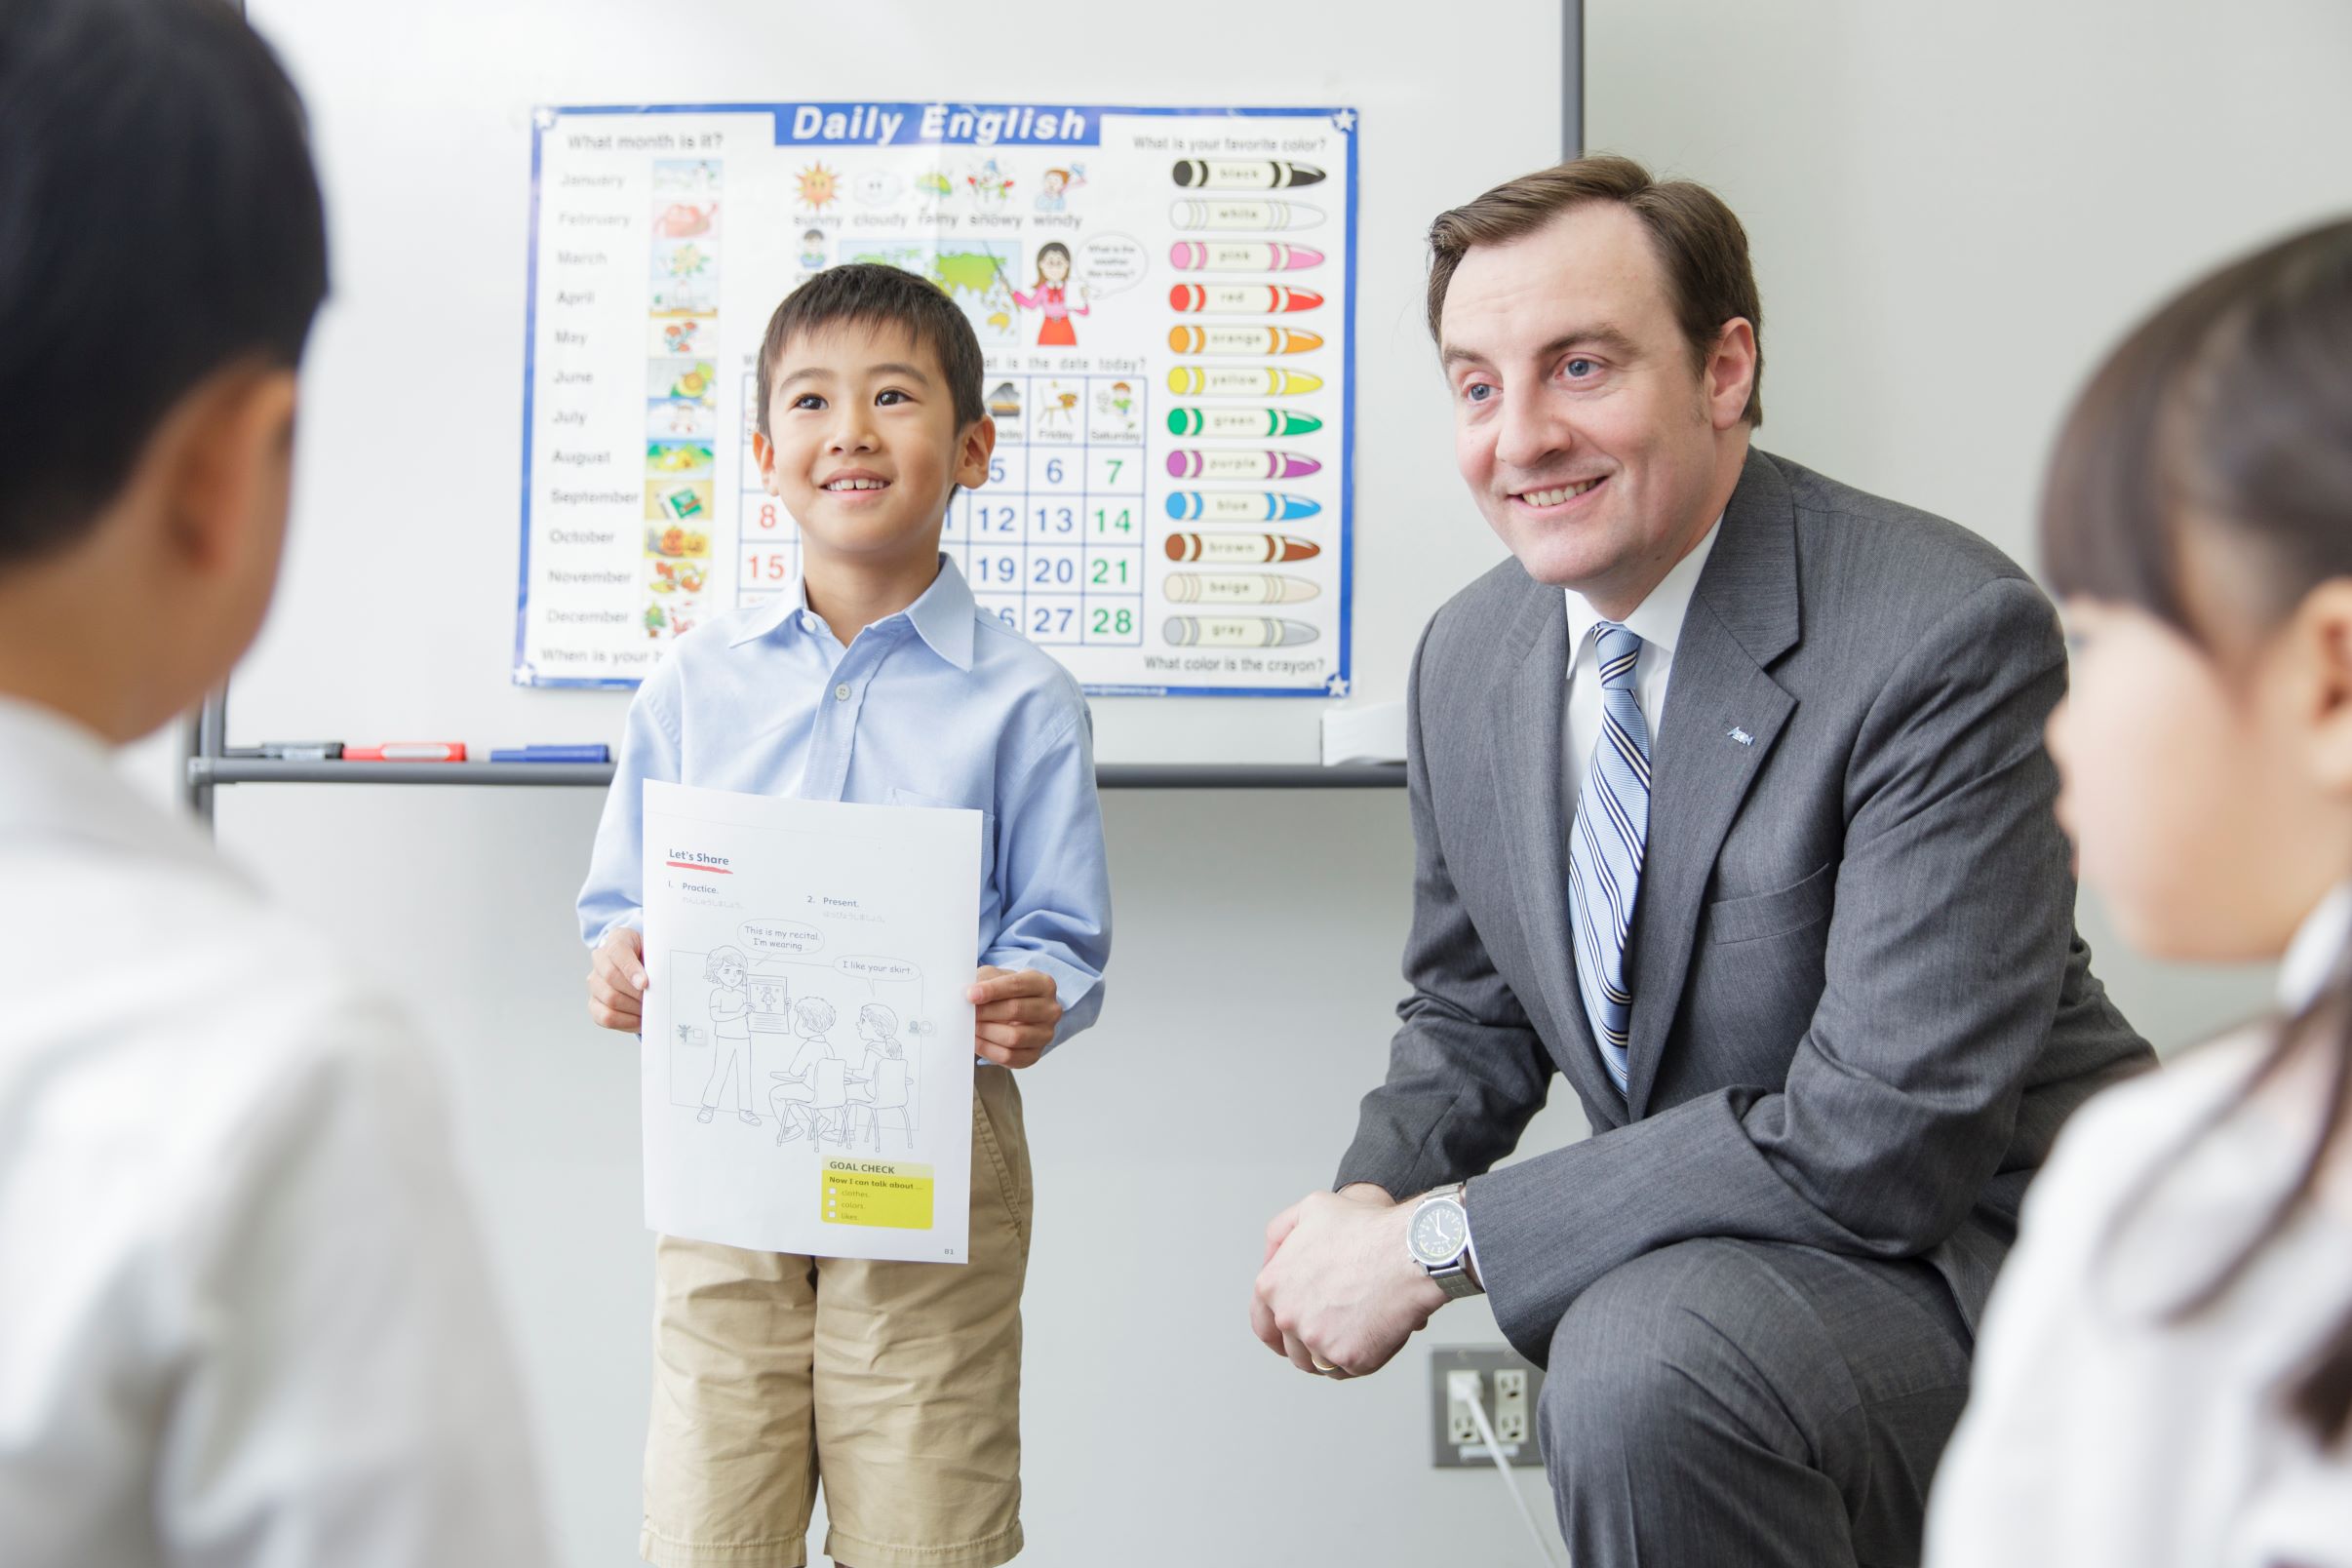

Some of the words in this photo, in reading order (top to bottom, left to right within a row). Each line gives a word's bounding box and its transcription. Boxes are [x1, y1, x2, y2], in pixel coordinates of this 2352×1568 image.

[792, 105, 904, 145] Daily
[920, 103, 1087, 145] English
[568, 135, 612, 149] What
[617, 135, 674, 149] month
[680, 135, 695, 149] is
[700, 134, 724, 148] it?
[1133, 137, 1168, 149] What
[1174, 137, 1184, 149] is
[1190, 139, 1220, 151] your
[1225, 137, 1276, 149] favorite
[1282, 137, 1326, 150] color?
[562, 174, 625, 188] January
[1219, 169, 1259, 179] black
[560, 212, 631, 227] February
[793, 216, 843, 229] sunny
[852, 213, 908, 229] cloudy
[918, 213, 959, 229] rainy
[968, 215, 1023, 229] snowy
[1034, 213, 1082, 229] windy
[1219, 209, 1258, 219] white
[558, 252, 608, 264] March
[1219, 252, 1250, 261] pink
[557, 292, 595, 306] April
[1220, 293, 1244, 302] red
[556, 332, 588, 345] May
[1212, 334, 1262, 345] orange
[1006, 357, 1018, 369] is
[1029, 357, 1049, 370] the
[1059, 358, 1088, 370] date
[1099, 357, 1147, 372] today?
[554, 372, 593, 384] June
[1212, 374, 1258, 386] yellow
[553, 412, 587, 425] July
[1214, 417, 1255, 427] green
[1039, 431, 1074, 441] Friday
[1091, 431, 1140, 442] Saturday
[553, 451, 610, 465] August
[1210, 459, 1256, 470] purple
[989, 458, 1005, 483] 5
[1046, 458, 1063, 484] 6
[1106, 459, 1123, 485] 7
[551, 490, 639, 506] September
[1217, 501, 1248, 511] blue
[760, 504, 776, 529] 8
[978, 507, 1016, 531] 12
[1037, 508, 1073, 532] 13
[1095, 509, 1131, 533] 14
[549, 529, 614, 543] October
[1210, 543, 1255, 553] brown
[749, 554, 785, 579] 15
[978, 558, 1016, 582] 19
[1034, 559, 1074, 583] 20
[1092, 560, 1126, 583] 21
[548, 570, 632, 583] November
[1210, 582, 1250, 594] beige
[546, 609, 628, 623] December
[1035, 608, 1074, 633] 27
[1092, 608, 1132, 634] 28
[1212, 626, 1244, 637] gray
[541, 648, 587, 662] When
[592, 648, 607, 662] is
[612, 651, 648, 665] your
[1145, 656, 1180, 670] What
[1184, 657, 1220, 671] color
[1225, 657, 1236, 671] is
[1240, 657, 1263, 672] the
[1268, 658, 1324, 675] crayon?
[669, 848, 694, 861] Let's
[696, 853, 729, 866] Share
[683, 882, 719, 894] Practice.
[807, 895, 815, 904] 2.
[823, 897, 860, 908] Present.
[744, 925, 763, 936] This
[765, 927, 772, 936] is
[774, 930, 787, 939] my
[789, 930, 820, 941] recital.
[754, 938, 767, 947] I'm
[769, 940, 803, 952] wearing
[850, 961, 865, 971] like
[868, 964, 887, 973] your
[830, 1160, 859, 1172] GOAL
[861, 1163, 895, 1175] CHECK
[829, 1176, 847, 1185] Now
[871, 1179, 887, 1188] talk
[889, 1181, 914, 1190] about
